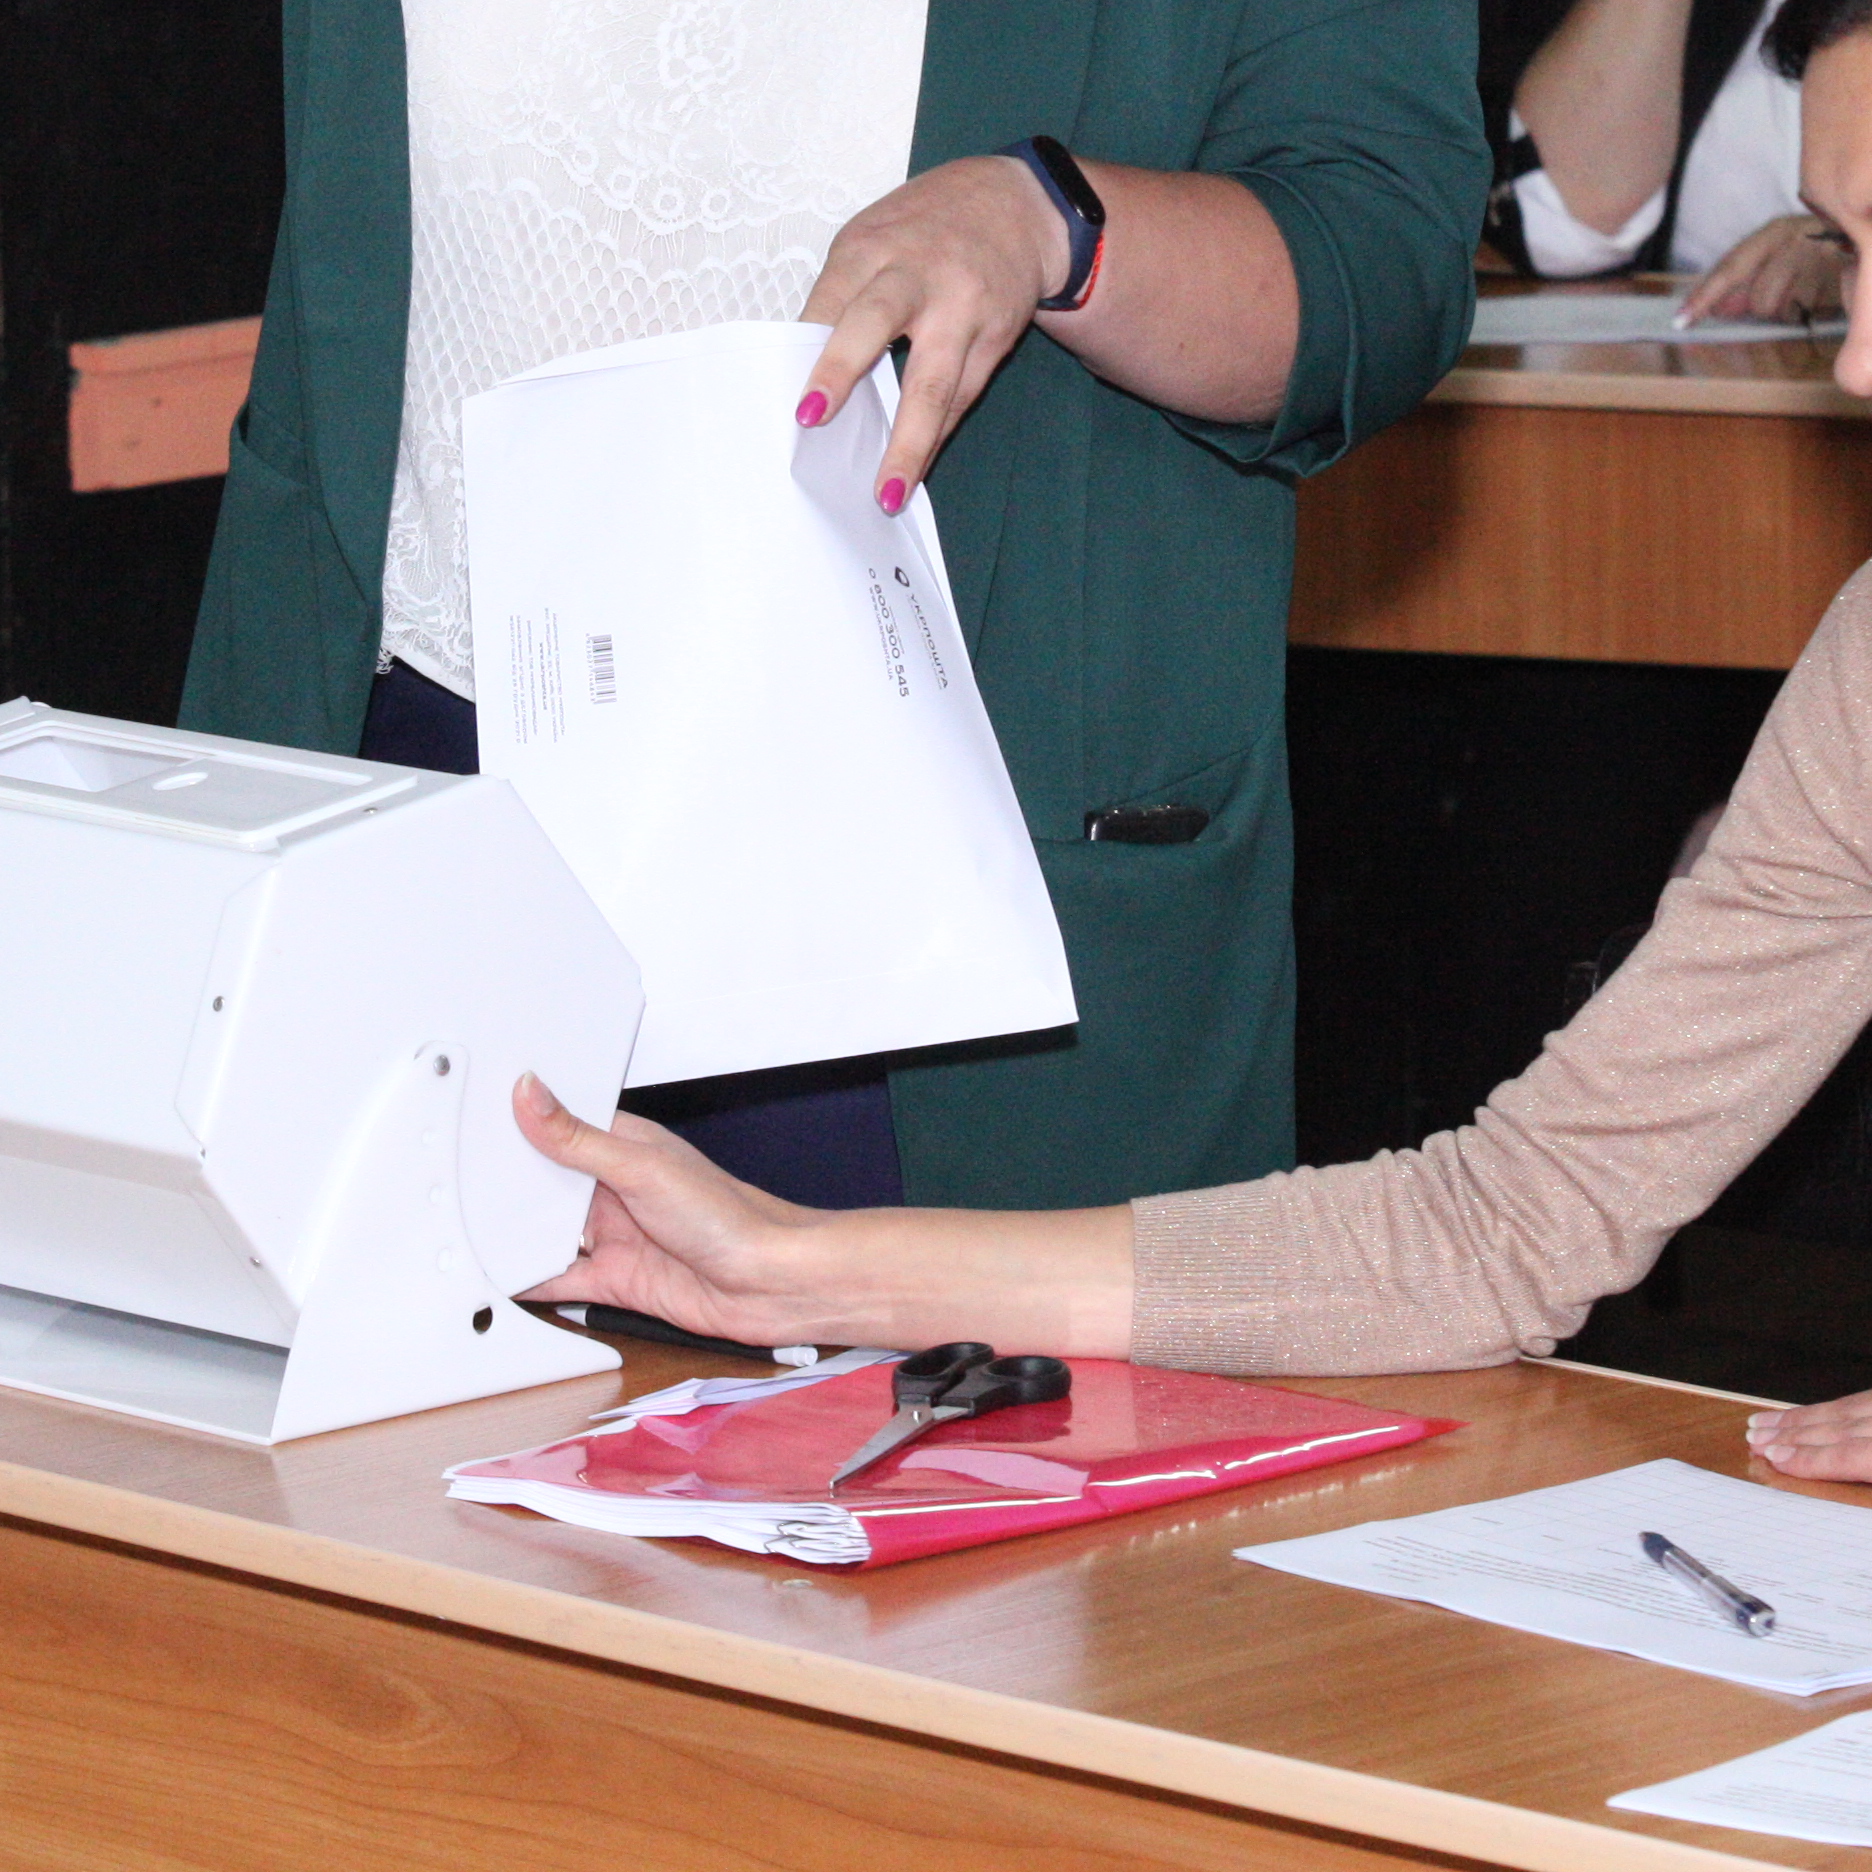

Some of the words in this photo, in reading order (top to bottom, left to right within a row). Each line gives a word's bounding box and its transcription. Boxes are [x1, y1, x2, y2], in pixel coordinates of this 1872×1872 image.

[868, 568, 876, 579] 0
[874, 584, 889, 619] 800
[886, 624, 901, 659] 300
[895, 664, 909, 697] 545
[910, 594, 948, 688] УКРПОШТА
